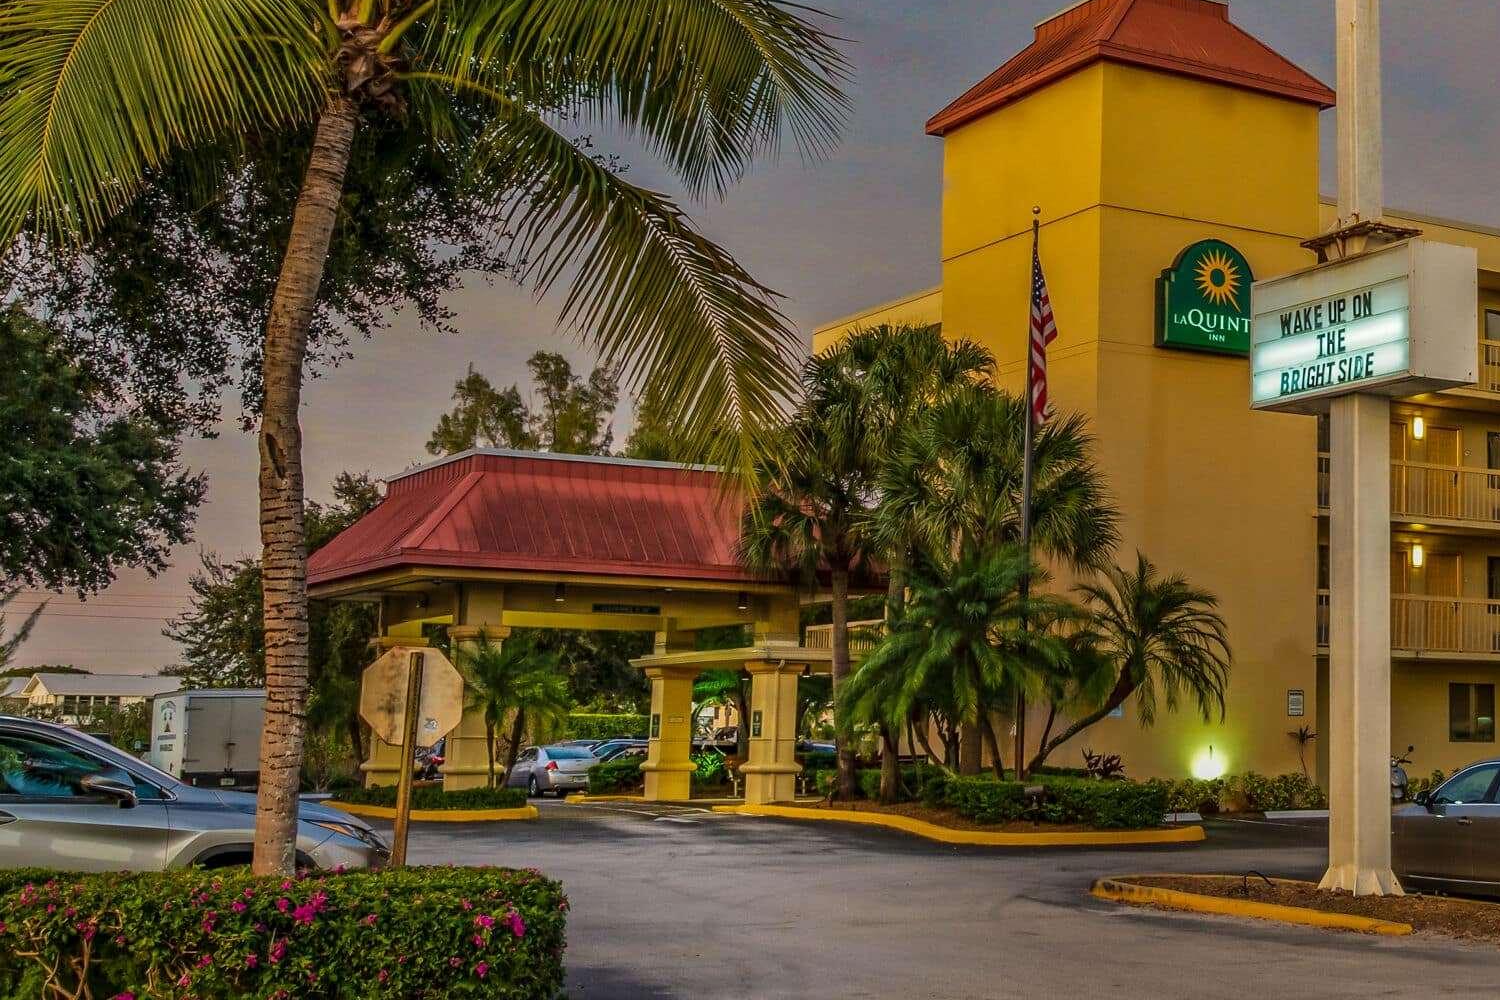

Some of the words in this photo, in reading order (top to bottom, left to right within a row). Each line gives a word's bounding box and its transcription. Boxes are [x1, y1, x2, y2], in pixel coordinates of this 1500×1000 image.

[1174, 313, 1187, 325] LA
[1187, 308, 1252, 333] QUINT
[1280, 304, 1322, 338] WAKE
[1328, 298, 1346, 325] UP
[1353, 291, 1372, 318] ON
[1208, 333, 1225, 342] INN
[1317, 328, 1346, 357] THE
[1280, 361, 1335, 396] BRIGHT
[1337, 352, 1374, 383] SIDE
